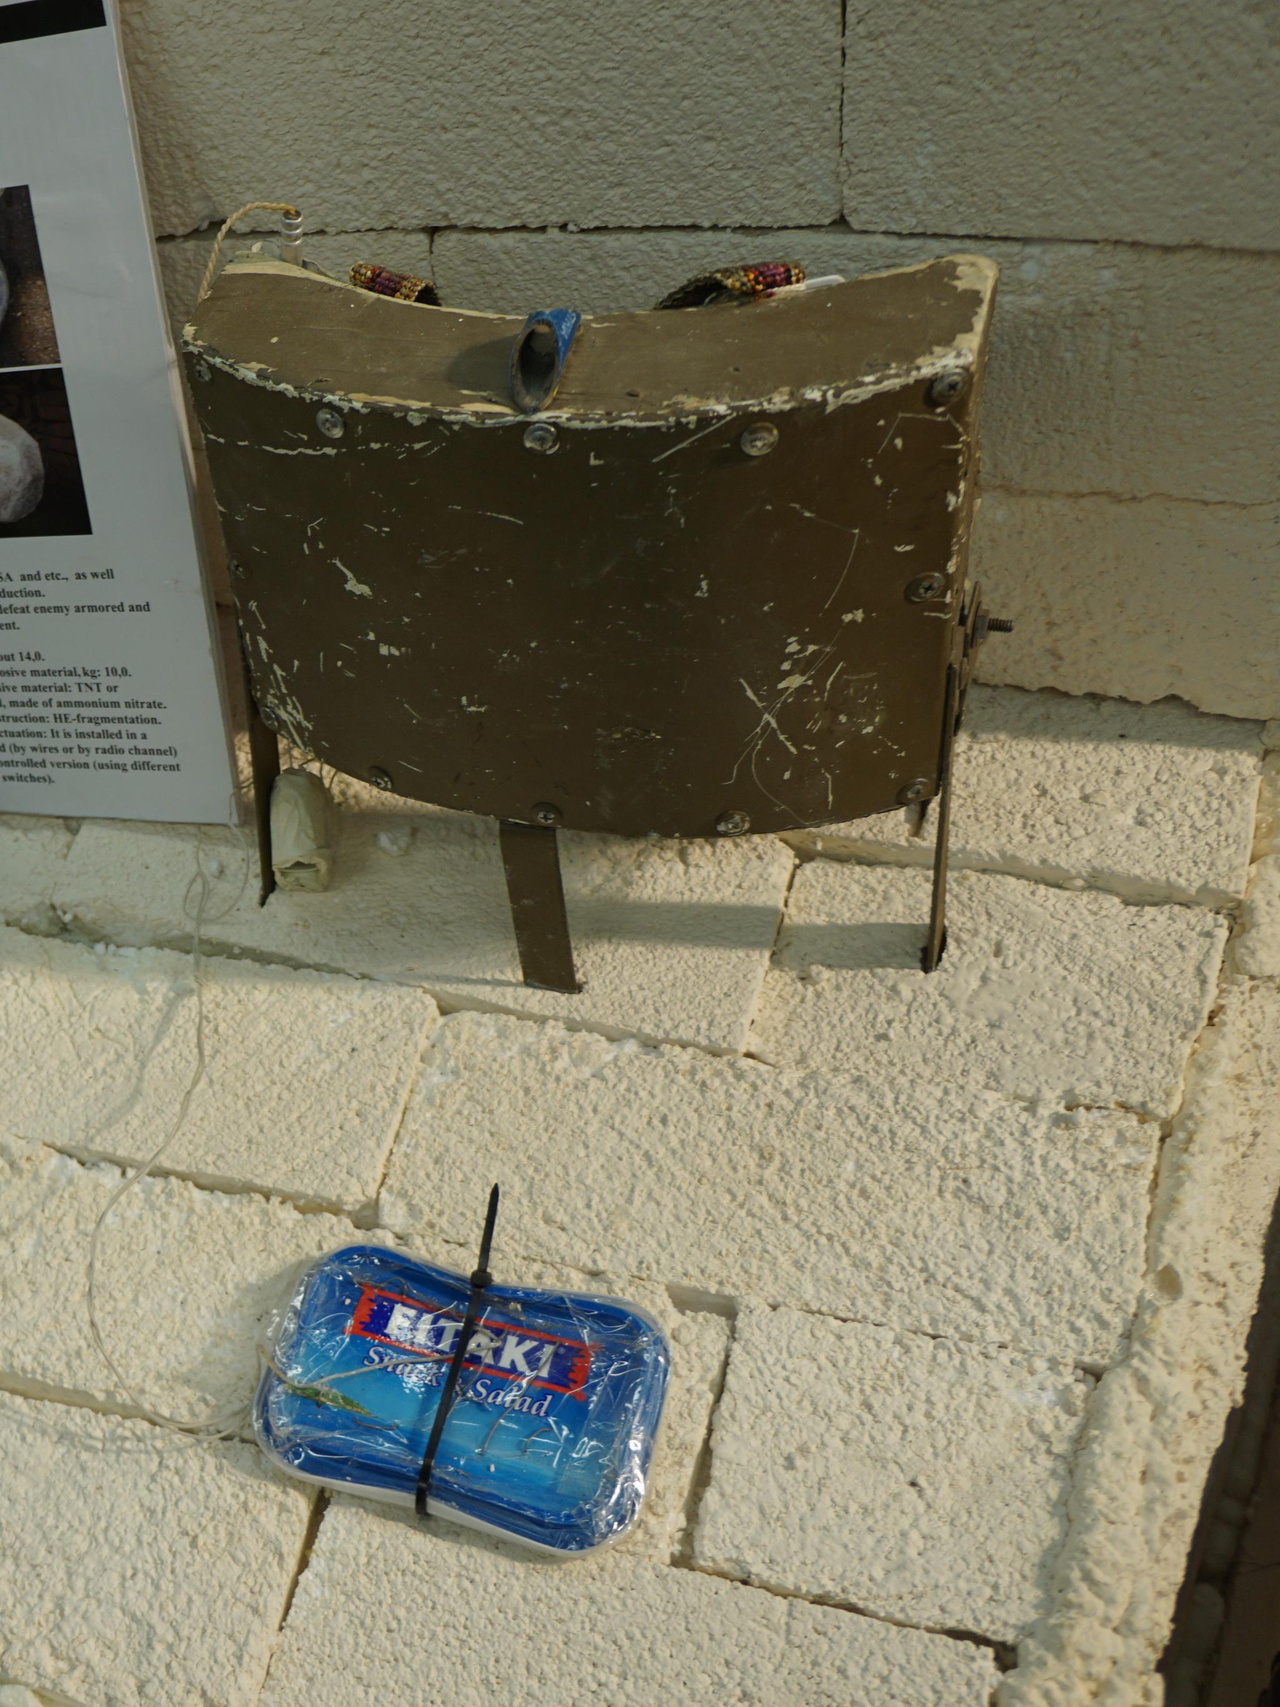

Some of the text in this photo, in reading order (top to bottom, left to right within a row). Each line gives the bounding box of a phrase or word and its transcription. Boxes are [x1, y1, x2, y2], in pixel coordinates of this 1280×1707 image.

[20, 572, 41, 582] and
[44, 571, 68, 582] etc.,
[75, 572, 87, 580] as
[90, 569, 114, 579] well
[33, 604, 70, 616] enemy
[74, 602, 125, 613] armored
[128, 602, 150, 612] and
[19, 652, 45, 663] 14,0.
[30, 666, 80, 678] material,
[82, 667, 101, 679] kg:
[105, 667, 132, 678] 10,0.
[21, 682, 71, 693] material:
[75, 683, 102, 693] TNT
[106, 685, 118, 693] or
[9, 699, 38, 708] made
[42, 698, 53, 708] of
[56, 700, 120, 709] ammonium
[124, 699, 167, 709] nitrate.
[53, 714, 162, 726] HE-fragmentation.
[50, 729, 60, 738] It
[63, 729, 72, 739] is
[75, 729, 123, 740] installed
[126, 730, 137, 740] in
[9, 743, 26, 755] (by
[29, 743, 59, 754] wires
[62, 746, 74, 754] or
[77, 744, 91, 756] by
[95, 744, 125, 755] radio
[128, 745, 177, 757] channel)
[50, 760, 90, 770] version
[93, 761, 128, 772] (using
[131, 761, 180, 772] different
[2, 773, 54, 784] switches).
[475, 1379, 553, 1417] Salad
